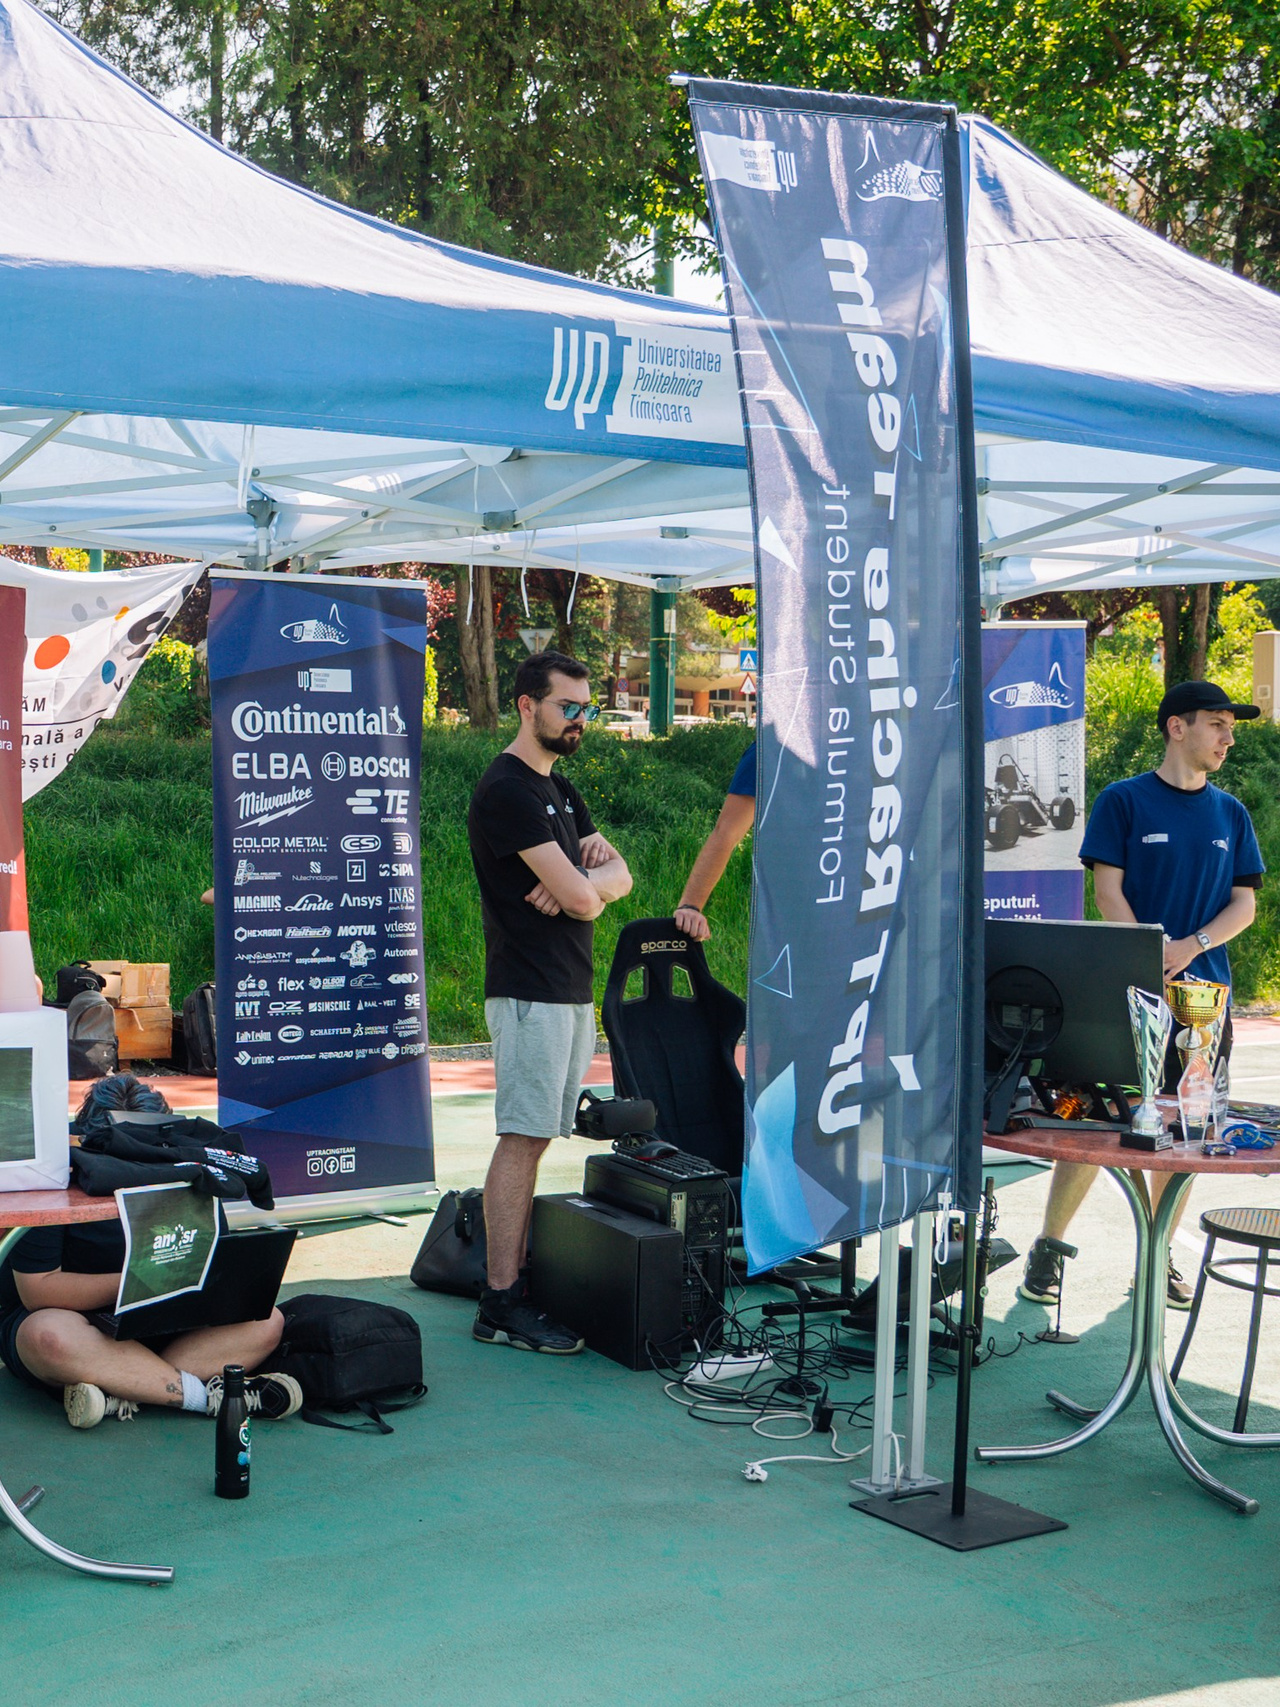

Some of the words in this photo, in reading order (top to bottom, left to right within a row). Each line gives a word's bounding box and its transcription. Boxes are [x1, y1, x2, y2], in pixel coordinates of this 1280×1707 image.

[638, 338, 721, 373] Universitatea
[633, 367, 703, 398] Politehnica
[630, 394, 693, 424] Timișoara
[231, 700, 389, 742] Continental
[232, 752, 312, 780] ELBA
[349, 756, 410, 779] BOSCH
[234, 785, 313, 820] Milwaukee
[384, 789, 410, 815] TE
[232, 837, 280, 849] COLOR
[284, 836, 327, 848] METAL
[233, 894, 282, 910] MAGNUS
[284, 893, 334, 912] Linde
[340, 893, 383, 910] Ansys
[388, 887, 415, 903] INAS
[984, 894, 1040, 912] eputuri.
[247, 928, 282, 937] HEXAGON
[337, 924, 377, 937] MOTUL
[277, 976, 304, 991] flex
[235, 1001, 260, 1016] KVT
[310, 1027, 352, 1036] SCHAEFFLER
[251, 1053, 275, 1065] unimec
